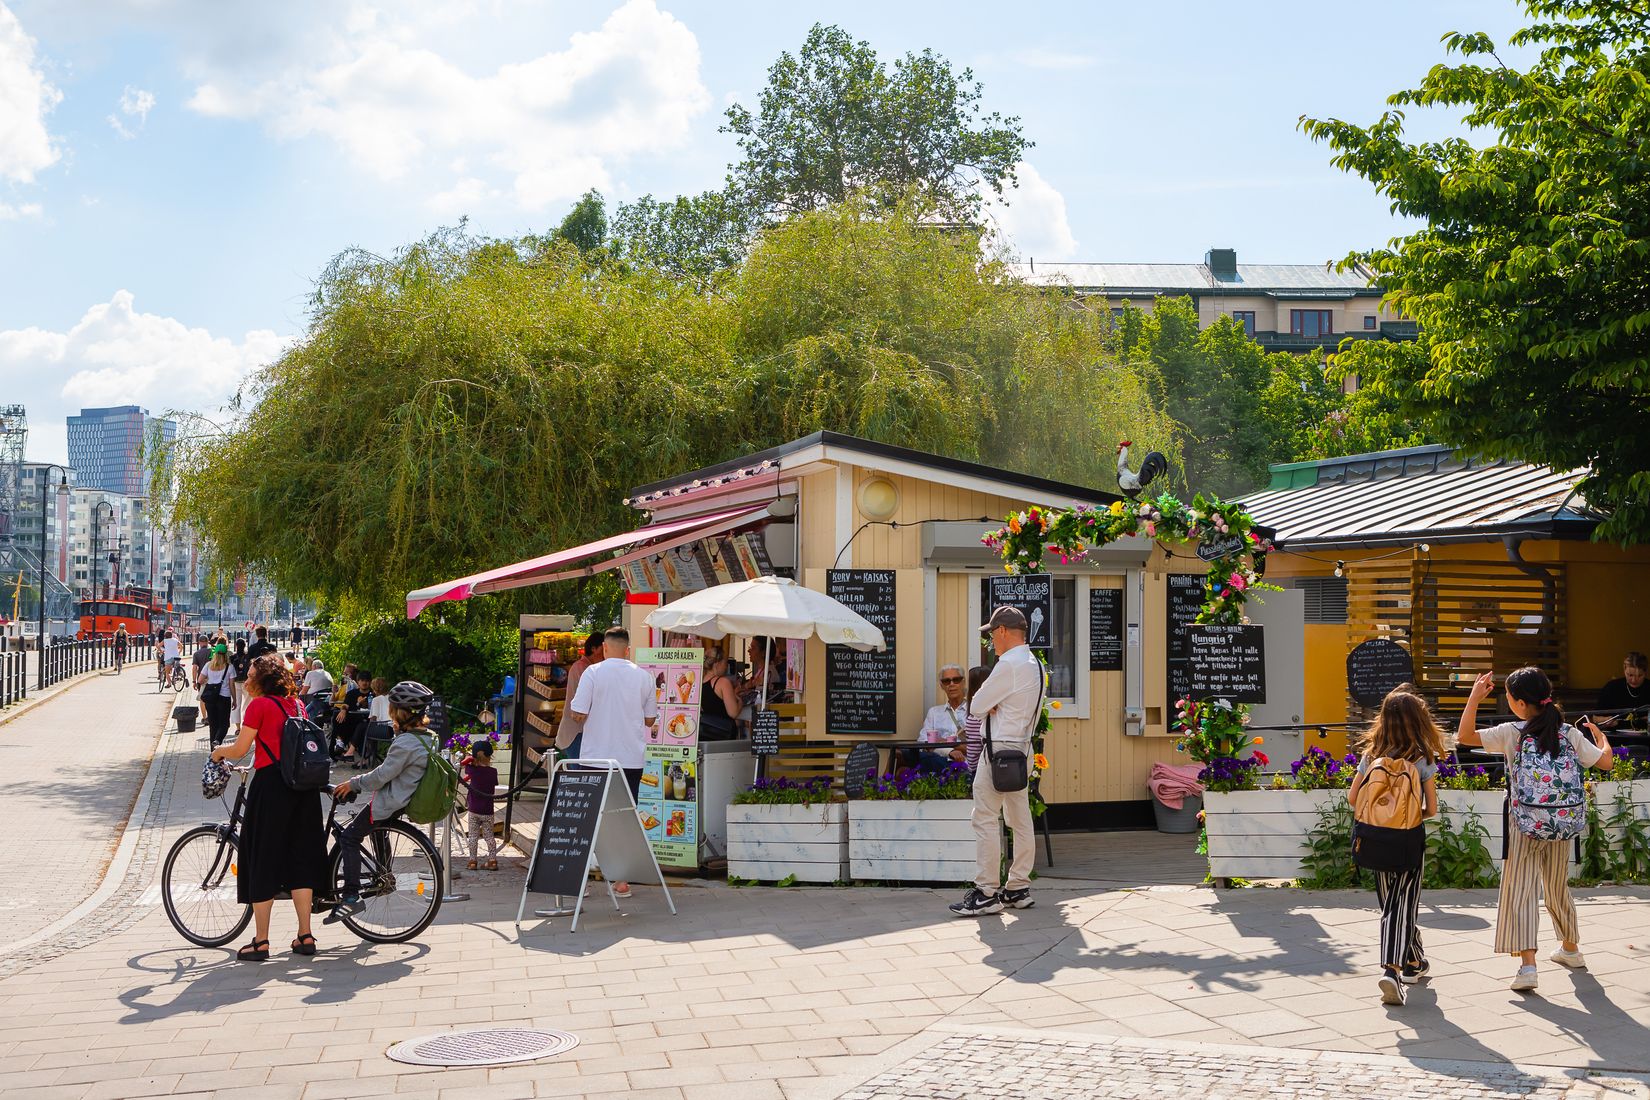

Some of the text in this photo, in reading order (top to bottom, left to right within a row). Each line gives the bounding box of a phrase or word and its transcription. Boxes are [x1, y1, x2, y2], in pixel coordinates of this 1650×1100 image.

[832, 572, 851, 581] KORV
[863, 572, 889, 582] KAJSAS
[994, 583, 1049, 595] KULGLASS
[1191, 633, 1234, 645] Hungrig ?
[657, 649, 694, 660] KAJSAS PÅ KAJEN
[833, 652, 851, 660] VEGO
[850, 670, 888, 679] MARRAKESH
